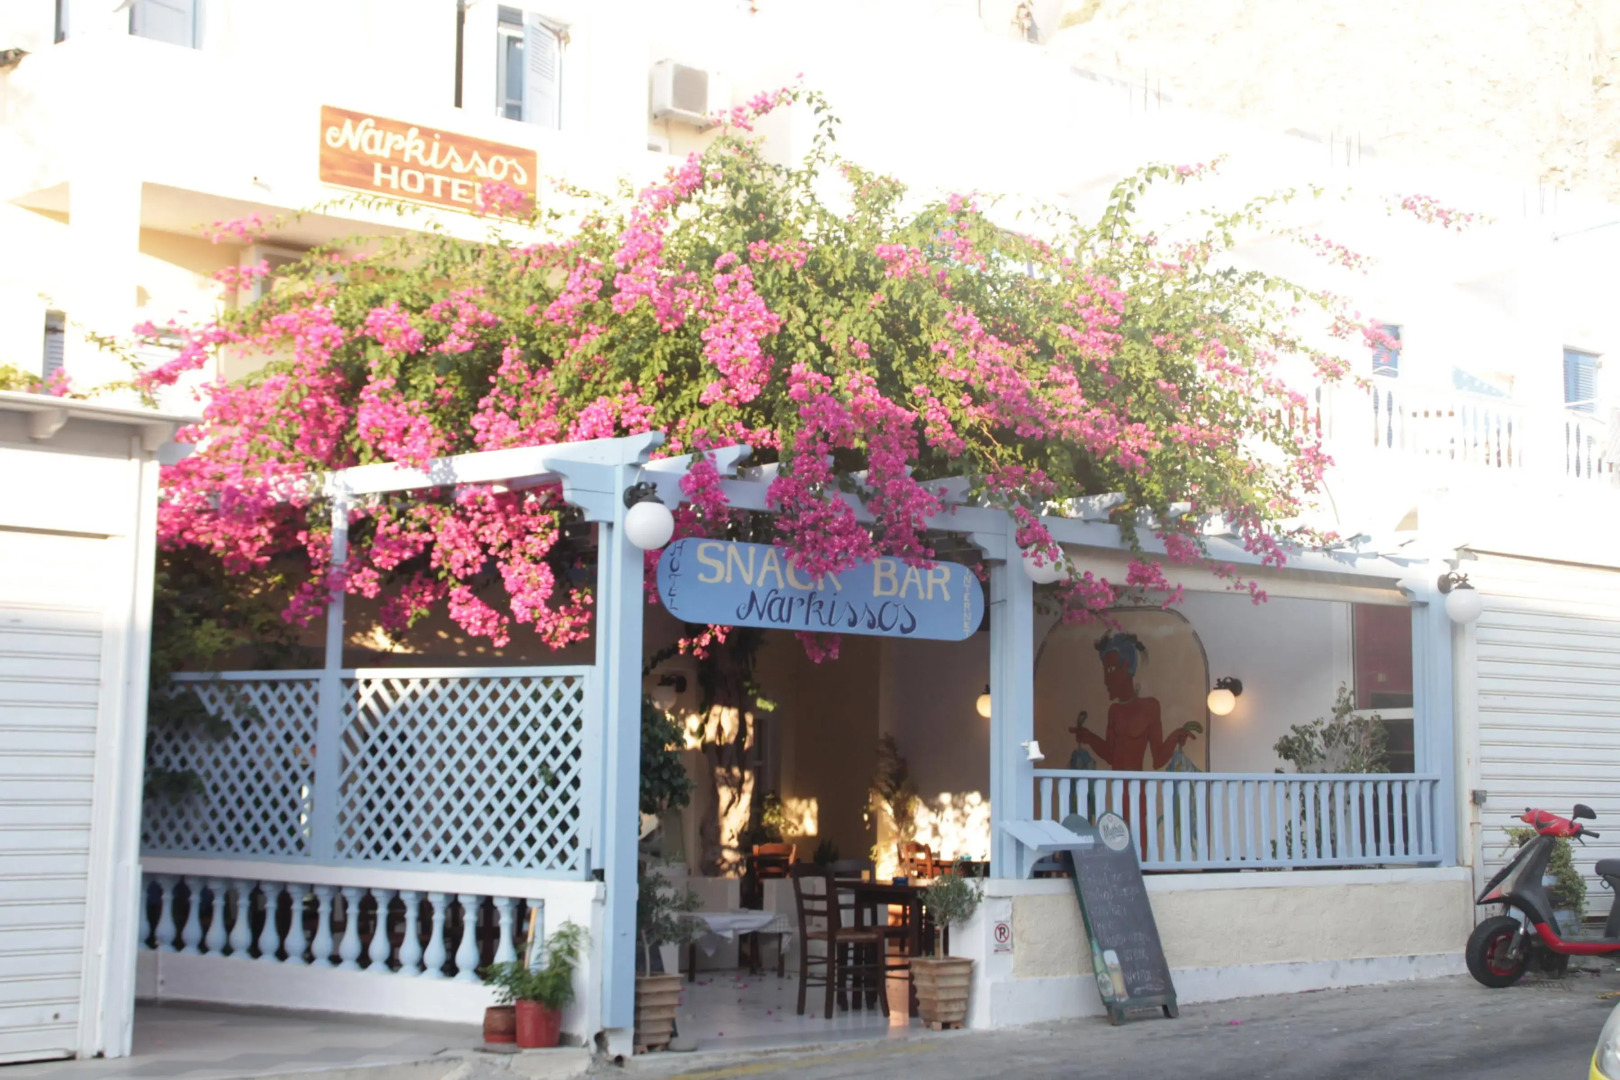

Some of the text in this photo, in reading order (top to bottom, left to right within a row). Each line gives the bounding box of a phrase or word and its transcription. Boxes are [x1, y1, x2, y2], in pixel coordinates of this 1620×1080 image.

[325, 118, 528, 186] Narkissos
[668, 540, 686, 611] HOTEL
[873, 558, 950, 601] BAR
[963, 568, 972, 637] INTERNET
[736, 589, 917, 634] Narkissos
